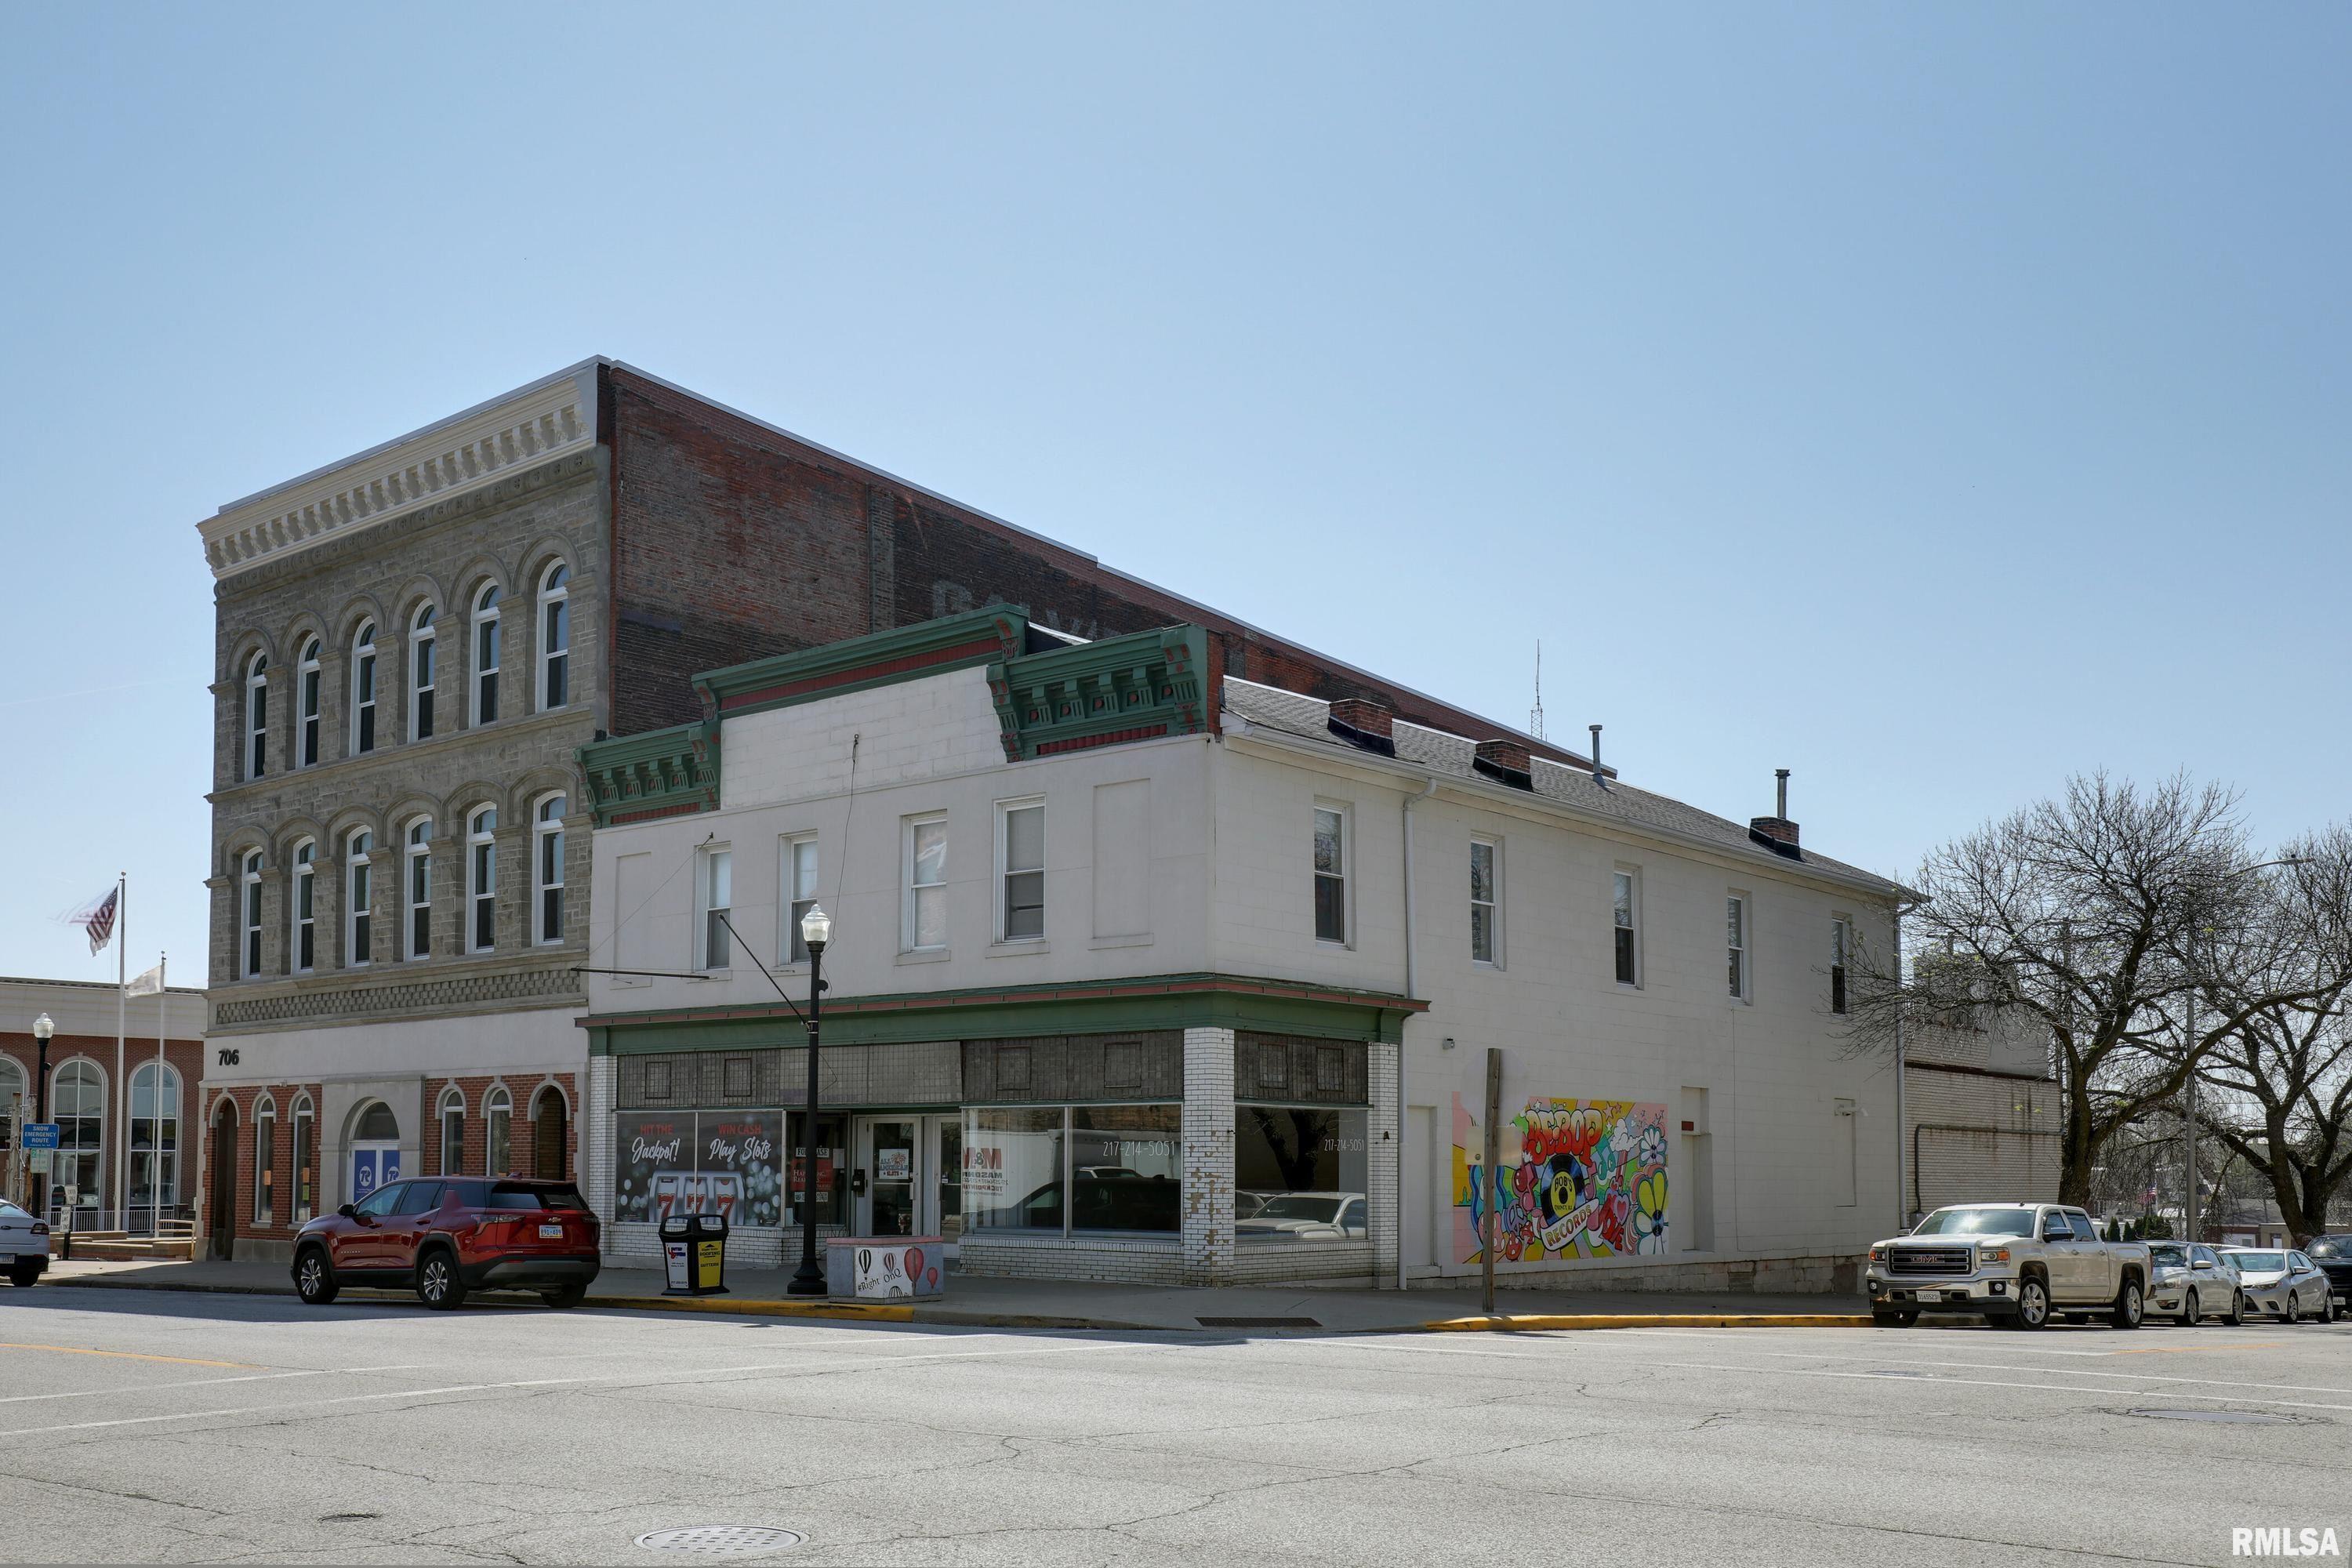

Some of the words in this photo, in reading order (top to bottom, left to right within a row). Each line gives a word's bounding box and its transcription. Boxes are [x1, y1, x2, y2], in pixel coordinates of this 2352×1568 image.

[218, 1049, 240, 1065] 706
[640, 1124, 655, 1135] HIT
[656, 1124, 674, 1135] THE
[718, 1124, 735, 1135] WIN
[736, 1124, 762, 1135] CASH
[632, 1137, 681, 1165] Jackpot!
[708, 1138, 737, 1162] Play
[742, 1136, 772, 1160] Slots
[1103, 1141, 1175, 1156] 217-214-5051
[1324, 1139, 1365, 1152] 217-214-5051
[1555, 1176, 1573, 1192] BOB'S
[1545, 1204, 1592, 1247] RECORDS
